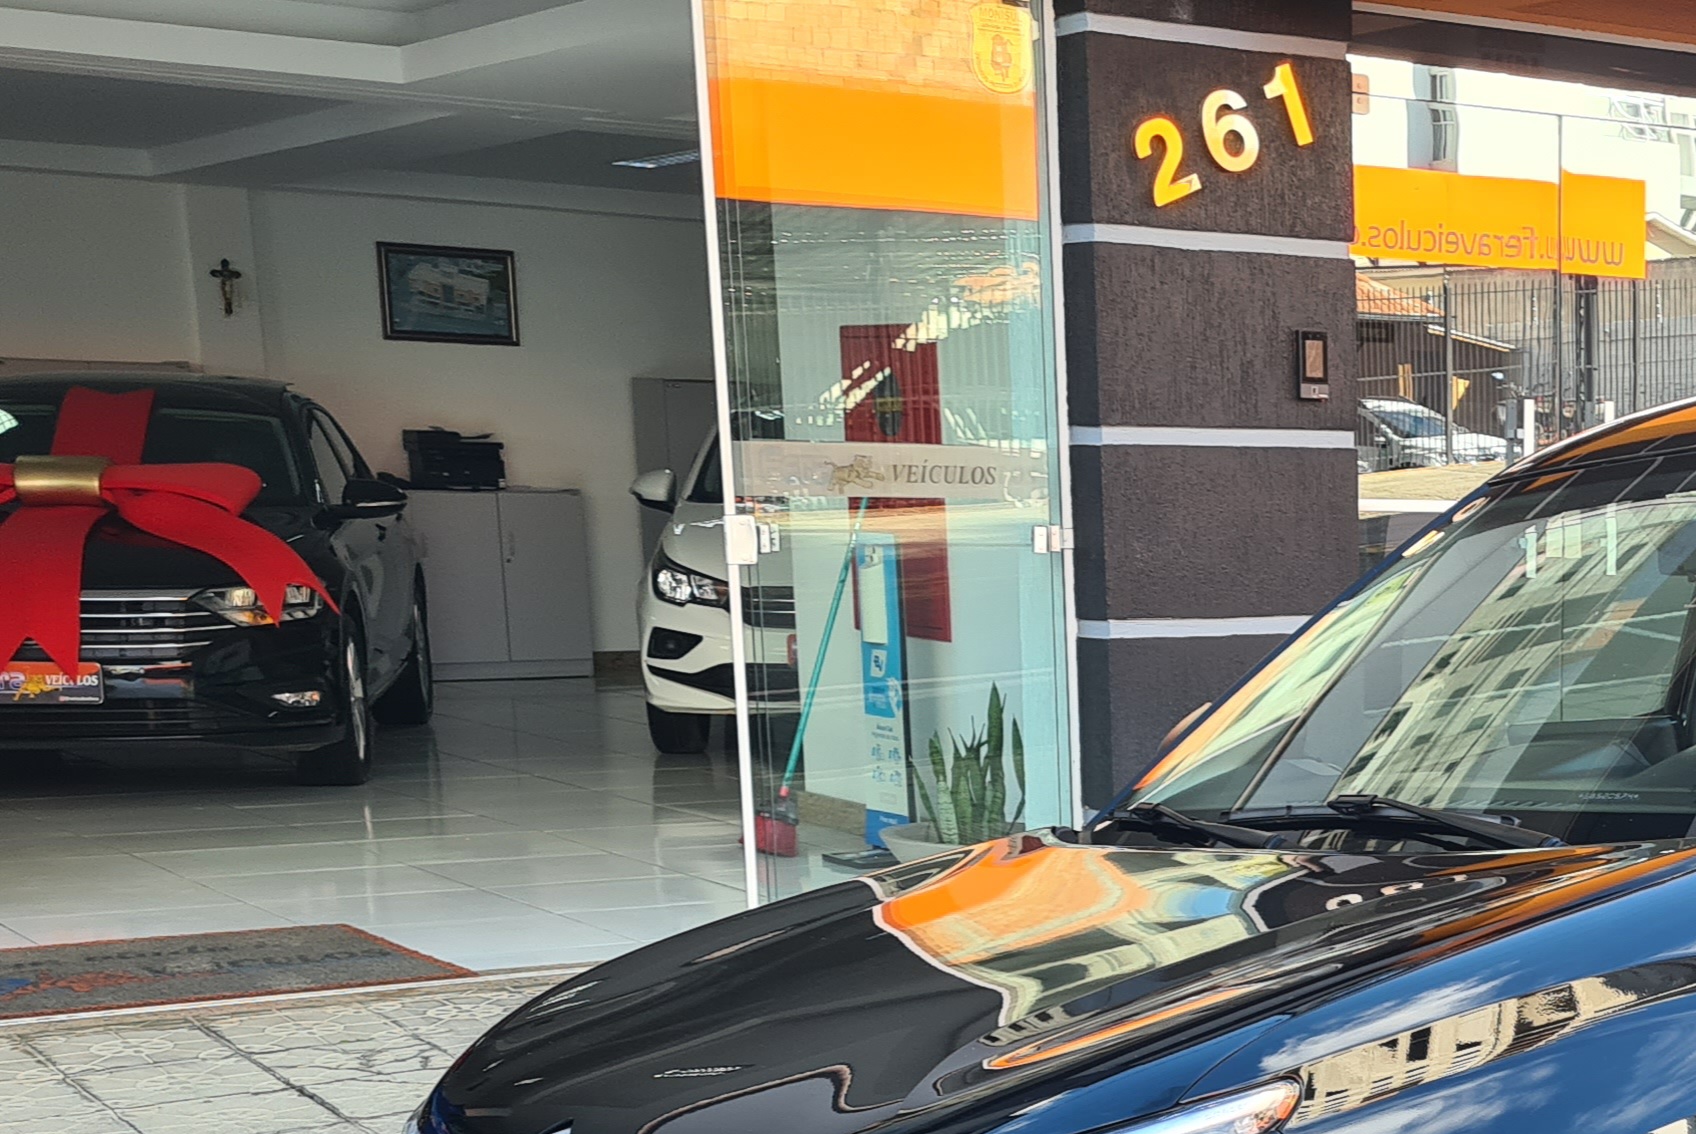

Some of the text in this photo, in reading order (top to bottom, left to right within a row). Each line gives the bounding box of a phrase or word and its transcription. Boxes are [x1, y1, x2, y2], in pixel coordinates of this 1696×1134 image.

[1135, 63, 1314, 207] 261
[892, 459, 997, 486] VEÍCULOS
[45, 671, 98, 686] VEÍCLOS
